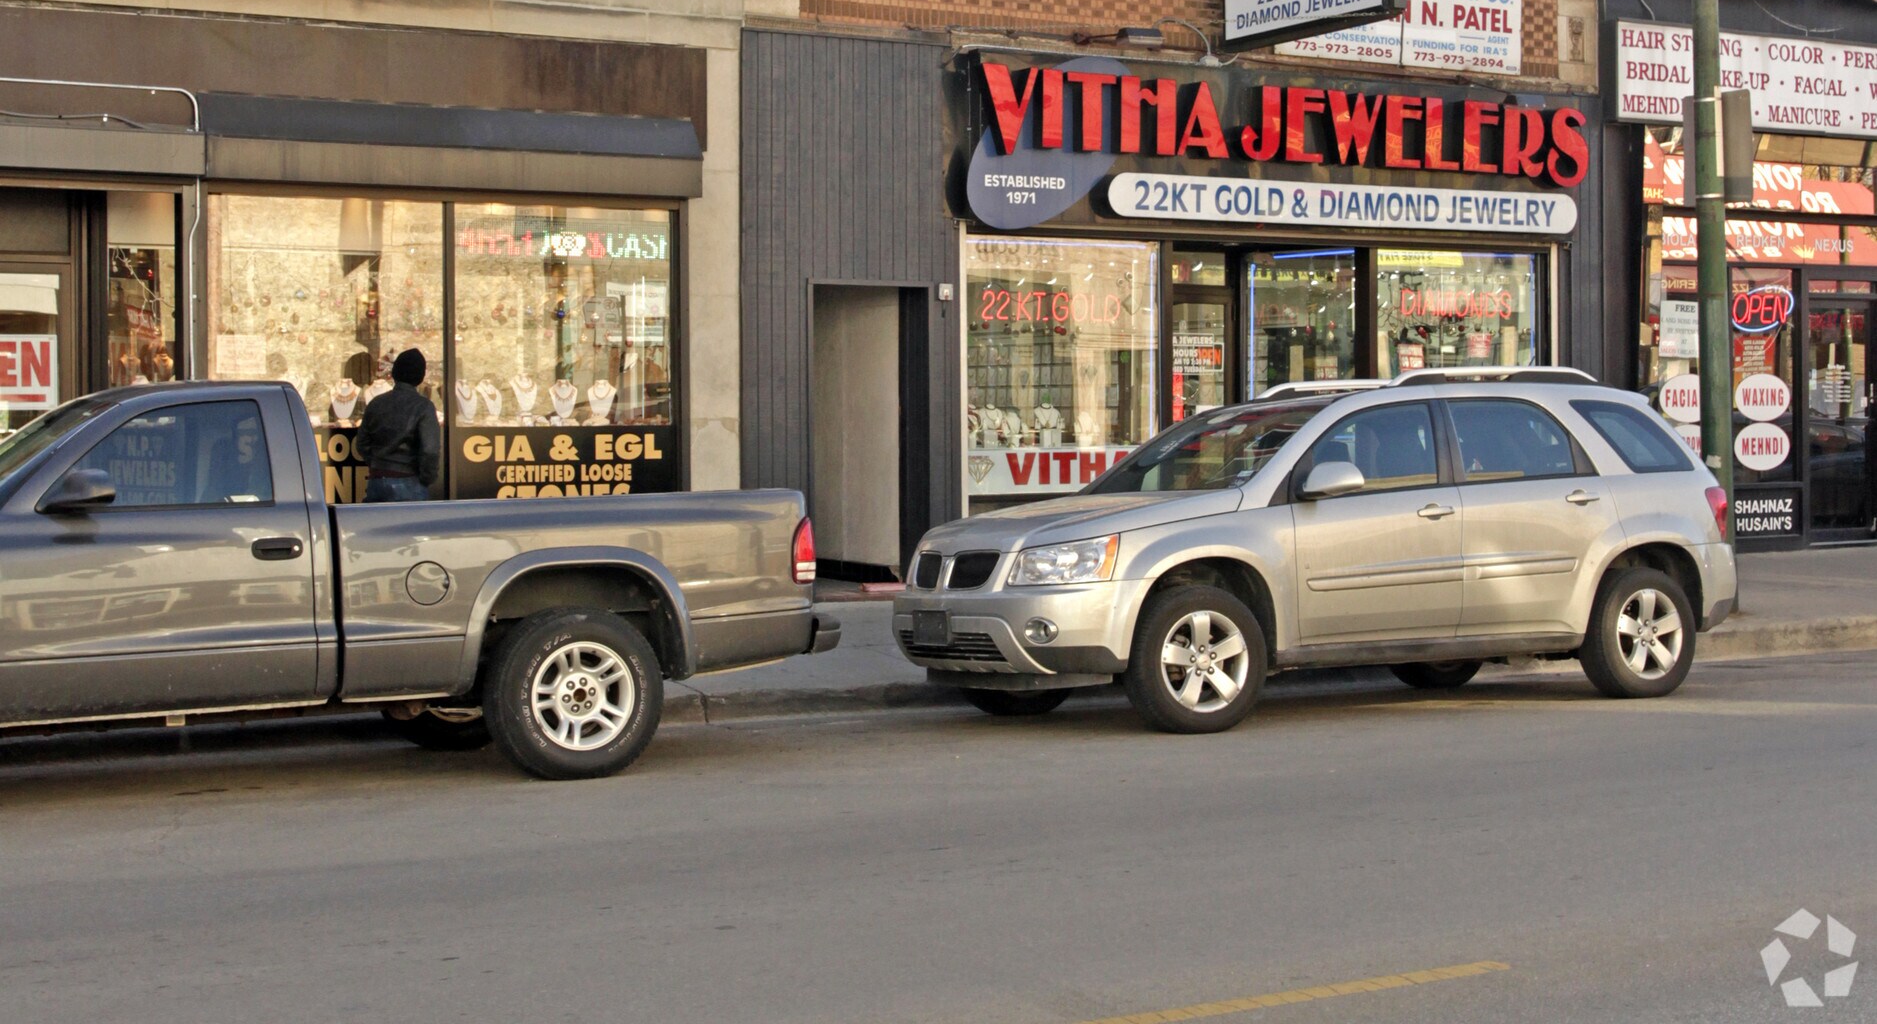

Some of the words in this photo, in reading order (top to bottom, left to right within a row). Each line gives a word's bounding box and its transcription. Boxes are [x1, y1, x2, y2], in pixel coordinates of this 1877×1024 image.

[1422, 1, 1443, 26] N.
[1453, 4, 1512, 33] PATEL
[1325, 32, 1401, 47] CONSERVATION
[1412, 39, 1455, 52] FUNDING
[1460, 44, 1479, 54] FOR
[1483, 46, 1508, 56] IRA'S
[1488, 35, 1509, 45] AGENT
[1294, 40, 1393, 59] 773-973-2805
[1621, 29, 1666, 50] HAIR
[1671, 33, 1742, 57] STNG
[1768, 43, 1824, 65] COLOR
[1843, 50, 1877, 71] PER
[1414, 51, 1503, 68] 773-973-2894
[1626, 61, 1691, 84] BRIDAL
[1794, 76, 1847, 97] FACIAL
[1622, 94, 1683, 115] MEHND
[1768, 105, 1841, 126] MANICURE
[981, 62, 1229, 158] VITHA
[1241, 85, 1590, 188] JEWELERS
[984, 174, 1065, 190] ESTABLISHED
[1006, 191, 1036, 205] 1971
[1134, 180, 1207, 213] 22KT
[1215, 184, 1284, 217] GOLD
[1291, 188, 1309, 219] &
[1319, 190, 1440, 222] DIAMOND
[1446, 196, 1556, 227] JEWELRY
[1736, 234, 1785, 248] REDKEN
[1814, 239, 1854, 253] NEXUS
[981, 290, 1010, 321] 22
[1051, 291, 1121, 322] GOLD
[1401, 287, 1512, 320] DIAMONDS
[1675, 303, 1696, 313] FREE
[1732, 293, 1789, 324] OPEN
[1179, 336, 1213, 345] JEWELERS
[1173, 349, 1198, 358] HOURS
[1665, 389, 1698, 407] FACIA
[1742, 388, 1784, 406] WAXING
[463, 434, 535, 462] GIA
[549, 434, 579, 461] &
[595, 433, 662, 461] EGL
[1742, 437, 1783, 455] MEHNDI
[496, 464, 575, 483] CERTIFIED
[581, 463, 632, 482] LOOSE
[1735, 498, 1793, 515] SHAHNAZ
[1736, 516, 1792, 532] HUSAIN'S
